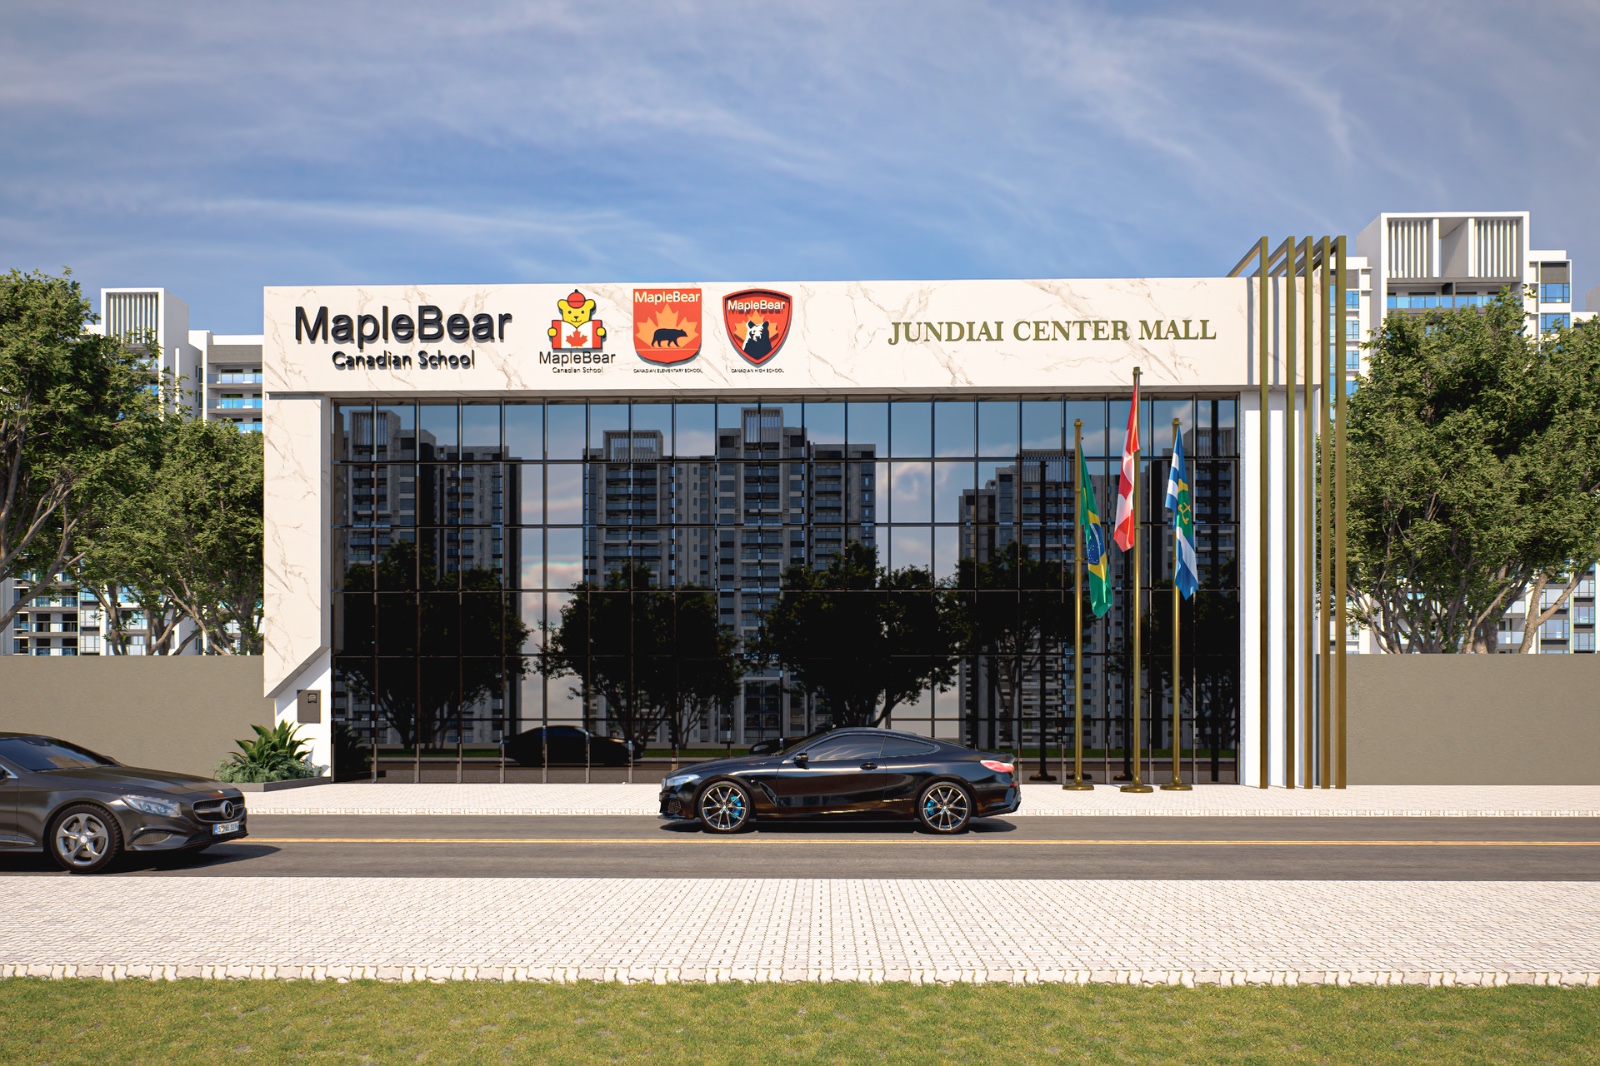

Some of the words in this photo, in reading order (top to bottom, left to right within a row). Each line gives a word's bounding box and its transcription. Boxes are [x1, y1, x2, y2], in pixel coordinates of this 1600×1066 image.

[634, 291, 700, 305] MapleBear
[727, 300, 785, 311] MapleBear
[295, 305, 512, 351] MapleBear
[888, 321, 1004, 346] JUNDIAI
[1013, 320, 1130, 341] CENTER
[1138, 319, 1217, 340] MALL
[332, 350, 412, 369] Canadian
[418, 349, 475, 369] School
[539, 351, 616, 367] MapleBear
